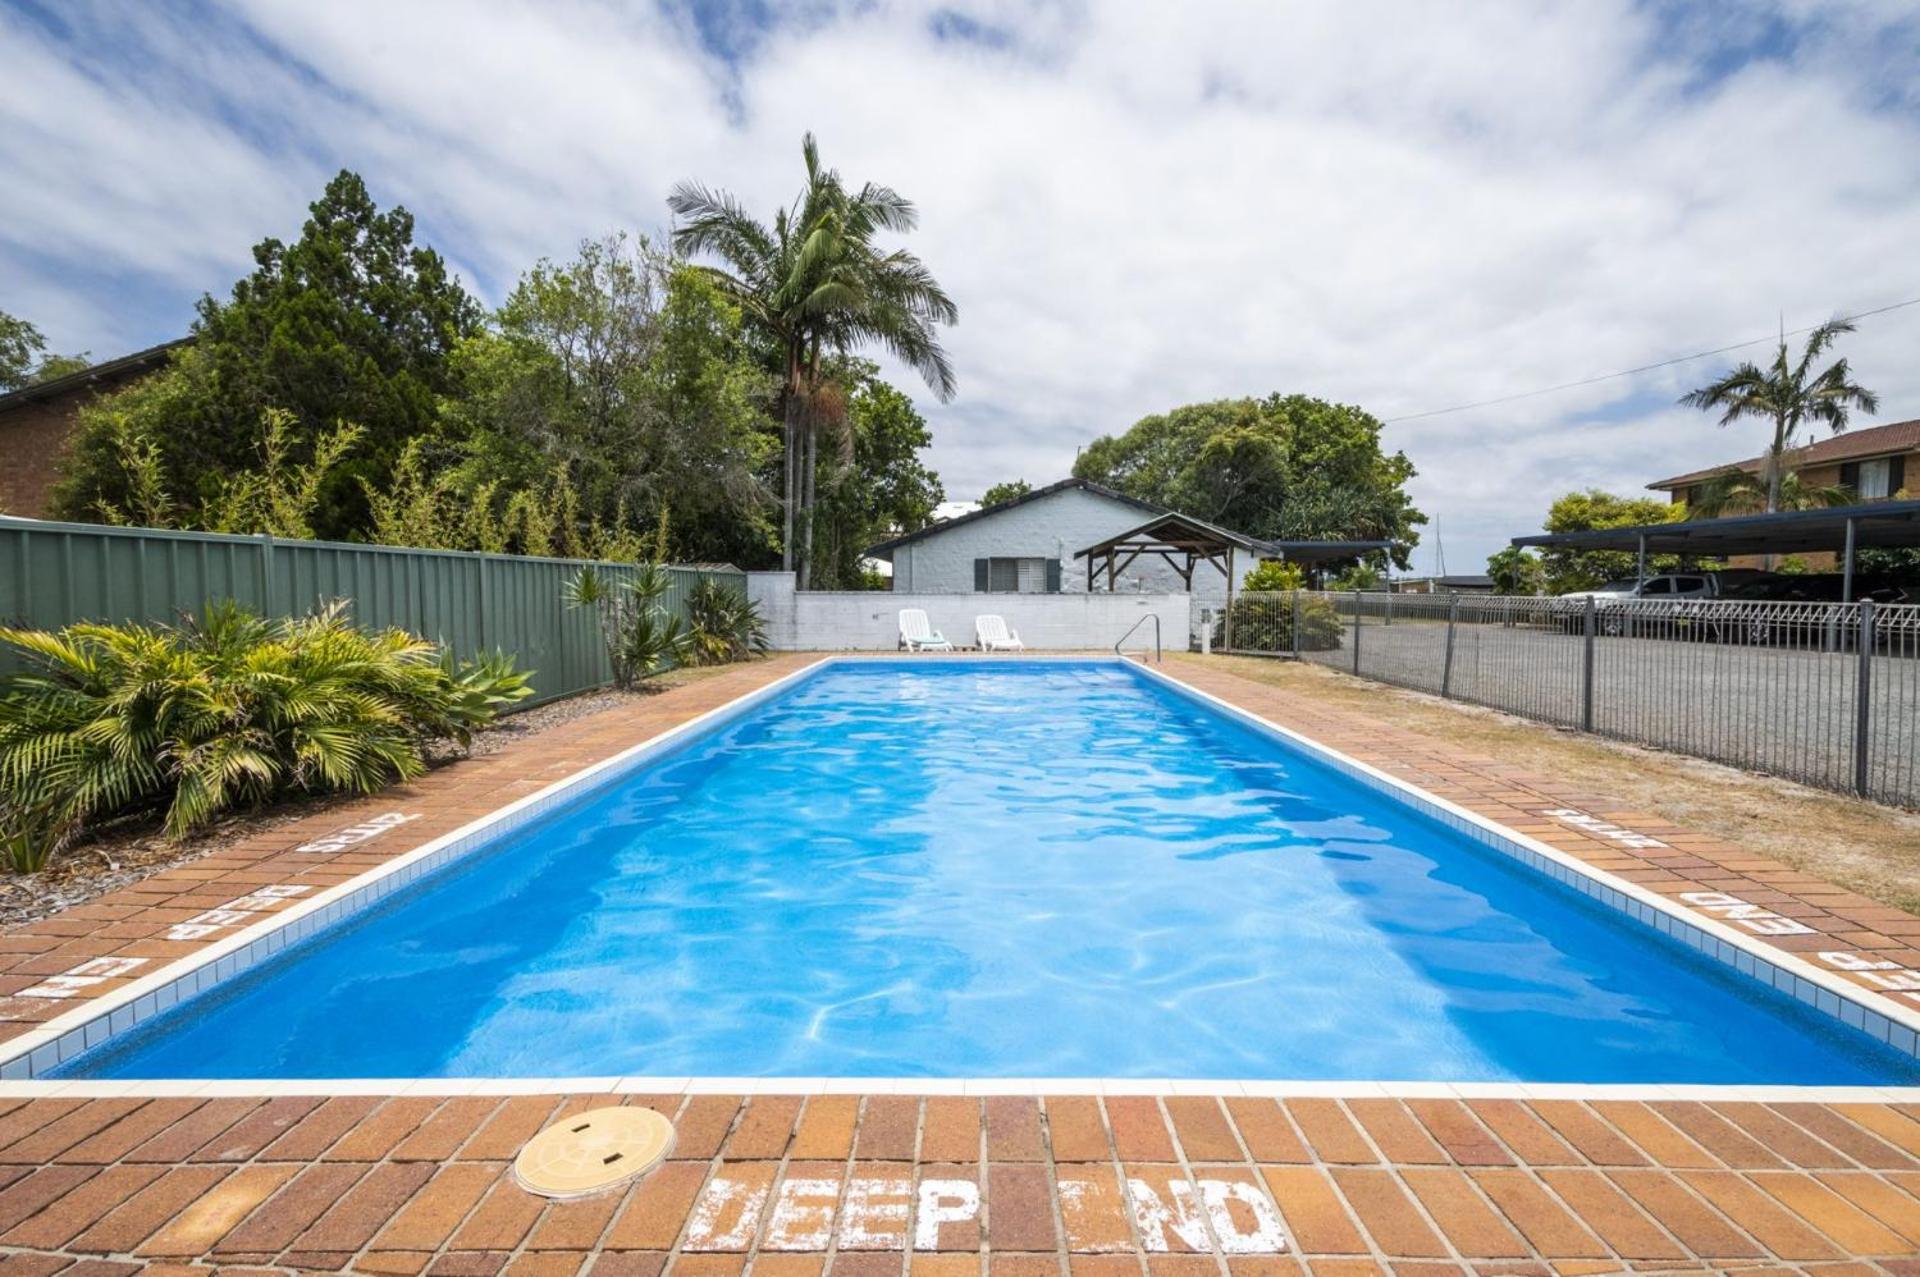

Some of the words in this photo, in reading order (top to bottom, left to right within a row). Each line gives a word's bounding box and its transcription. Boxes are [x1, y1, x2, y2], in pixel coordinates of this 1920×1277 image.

[168, 885, 312, 940] DEEP
[1680, 892, 1818, 935] END
[682, 1179, 979, 1251] DEEP
